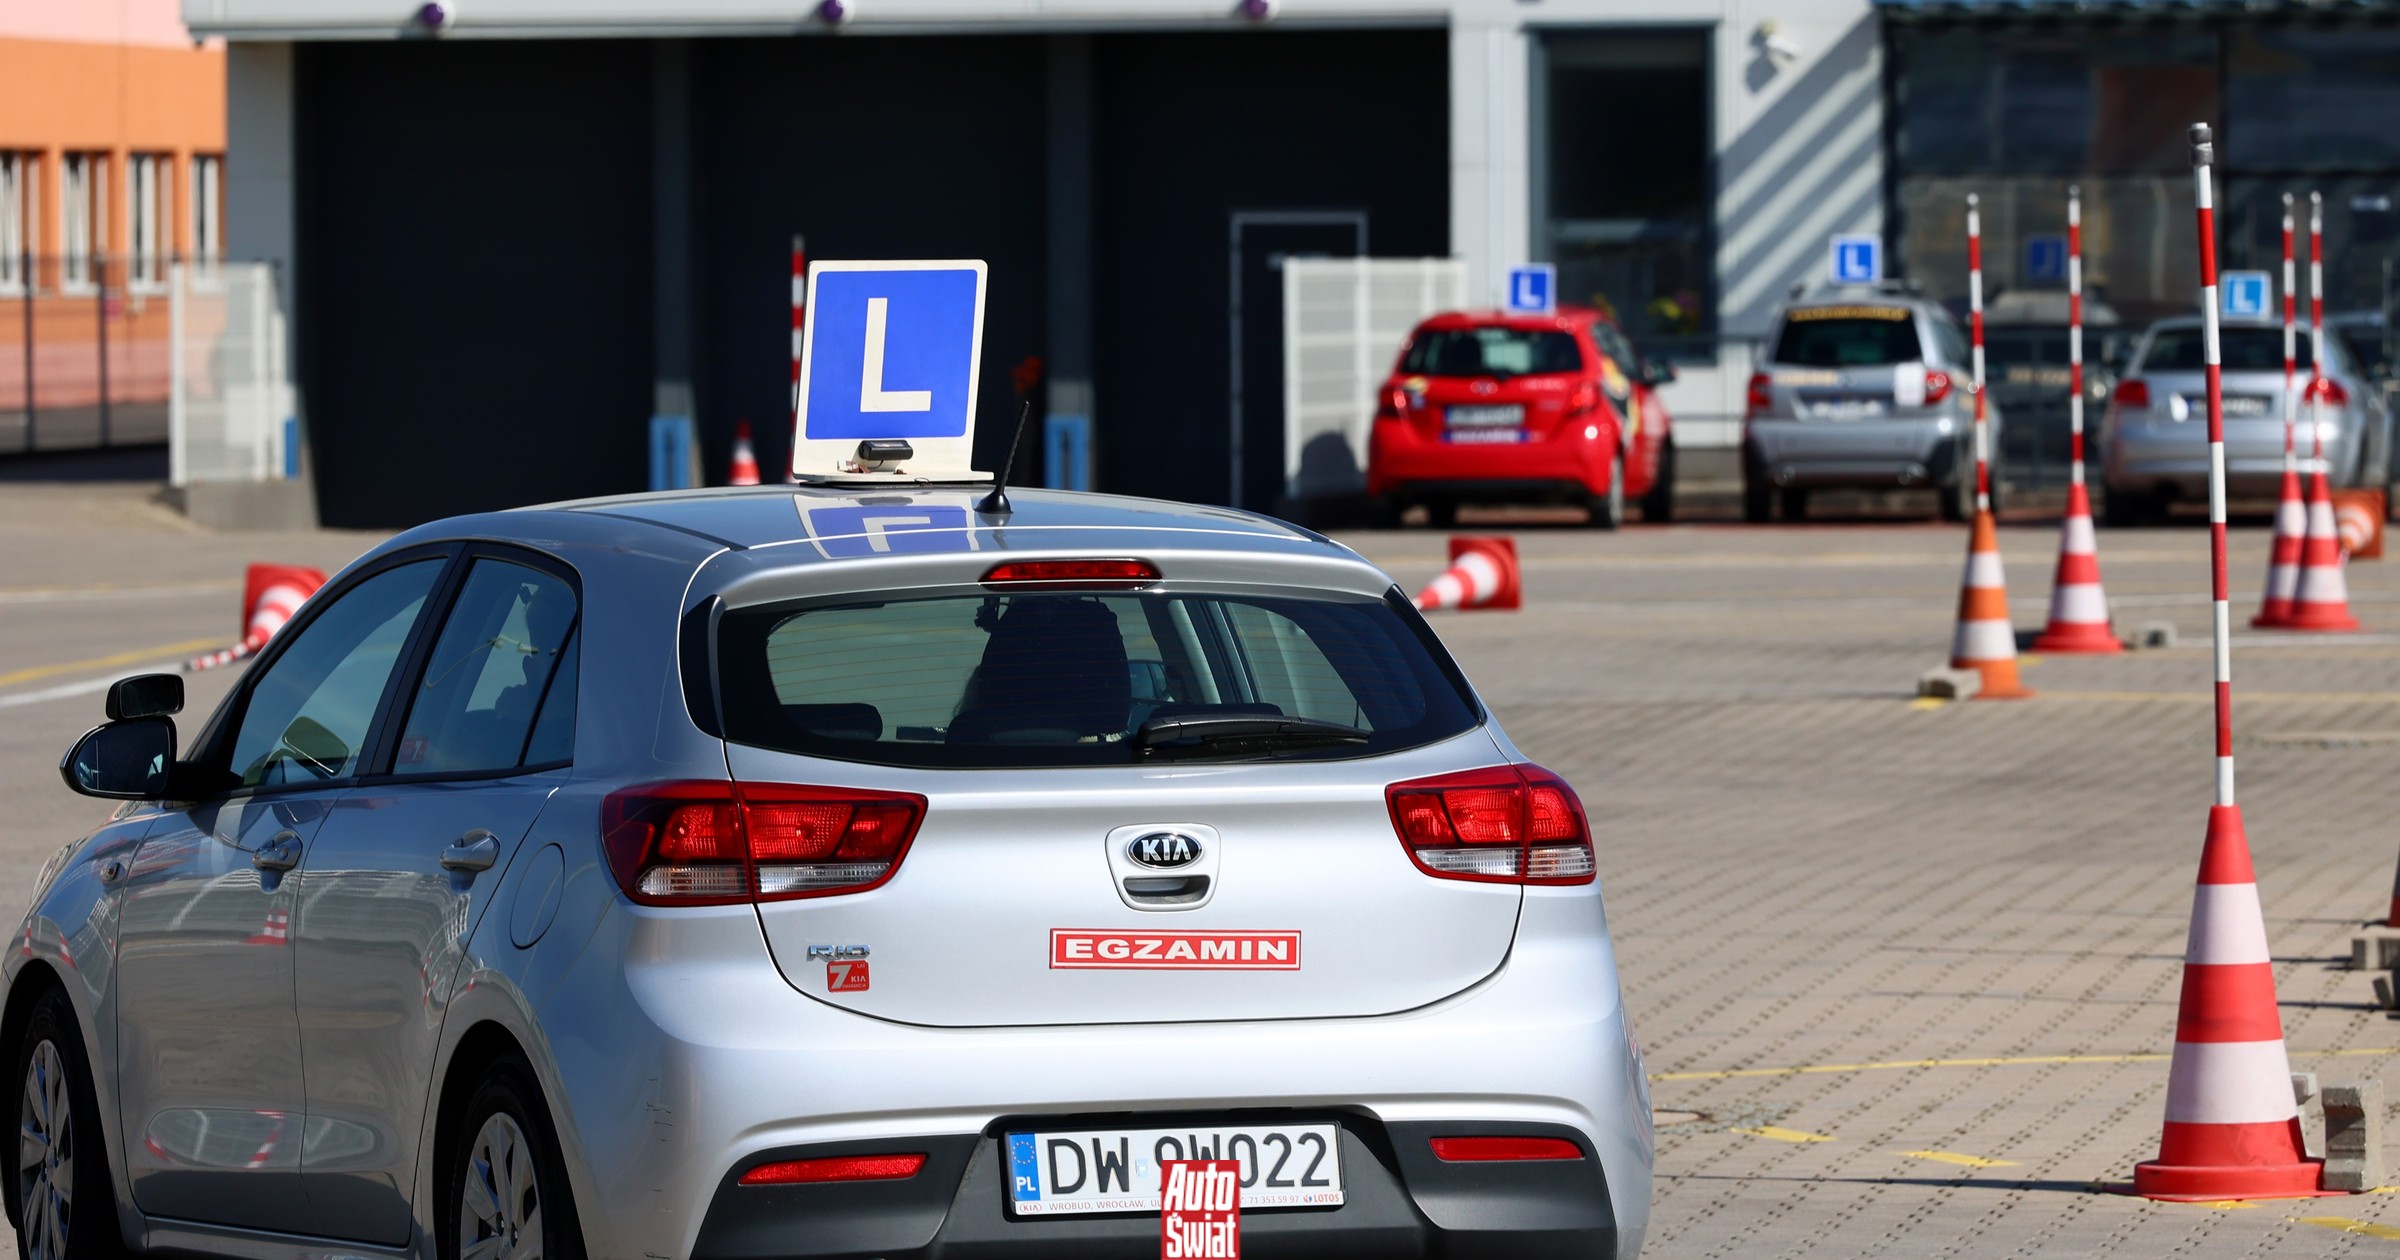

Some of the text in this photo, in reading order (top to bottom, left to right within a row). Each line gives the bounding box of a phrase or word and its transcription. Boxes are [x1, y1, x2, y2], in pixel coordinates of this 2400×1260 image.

[1845, 246, 1868, 278] L
[1519, 275, 1543, 307] L
[2233, 281, 2257, 313] L
[860, 297, 932, 412] L
[1141, 839, 1192, 862] KIA
[807, 944, 871, 962] RIO
[1065, 938, 1288, 961] EGZAMIN
[830, 964, 852, 989] 7
[850, 975, 866, 983] KIA
[1047, 1136, 1130, 1195] DW
[1016, 1176, 1036, 1192] PL
[1023, 1203, 1039, 1212] KIA
[1049, 1201, 1094, 1212] WROBUD,
[1096, 1199, 1146, 1210] WROCŁAW,
[1249, 1194, 1299, 1204] 71 353 59 97
[1313, 1193, 1340, 1203] LOTOS
